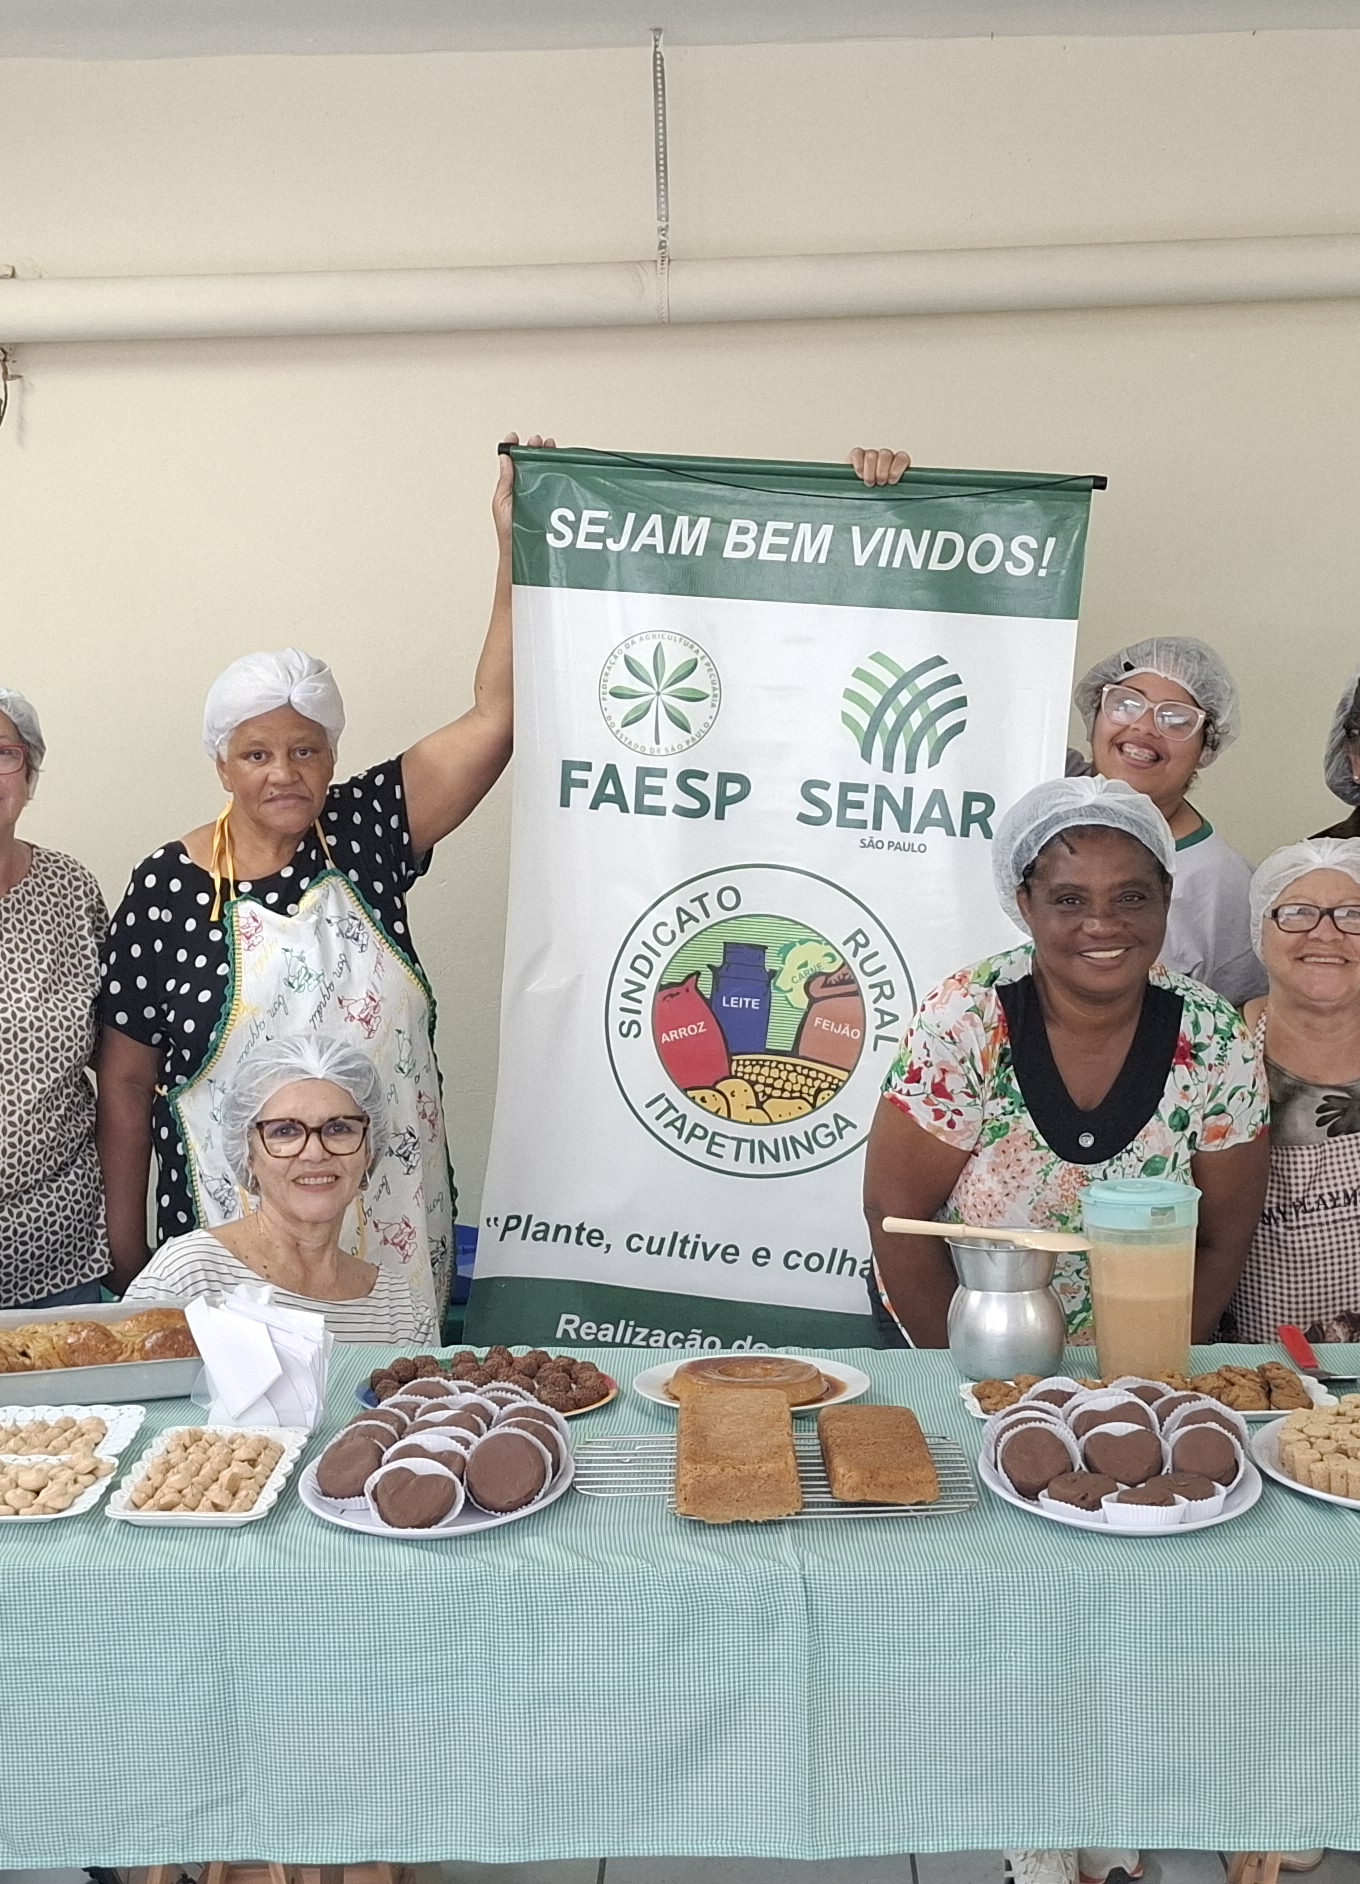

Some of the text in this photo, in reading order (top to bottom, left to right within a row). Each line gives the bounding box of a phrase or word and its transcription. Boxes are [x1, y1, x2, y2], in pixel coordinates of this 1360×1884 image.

[546, 508, 1056, 577] SEJAM BEM VINDOS!
[639, 633, 700, 655] AGRICULTURA
[559, 759, 752, 821] FAESP
[796, 778, 996, 840] SENAR
[859, 836, 927, 853] SÃO PAULO
[619, 885, 741, 1039] SINDICATO
[791, 962, 824, 984] CARNE
[722, 996, 760, 1010] LEITE
[842, 928, 899, 1052] RURAL
[661, 1021, 707, 1044] ARROZ
[814, 1017, 860, 1039] FEIJÃO
[645, 1092, 857, 1164] ITAPETININGA
[1260, 1204, 1290, 1226] MY
[625, 1231, 740, 1264] cultive
[751, 1246, 771, 1267] e
